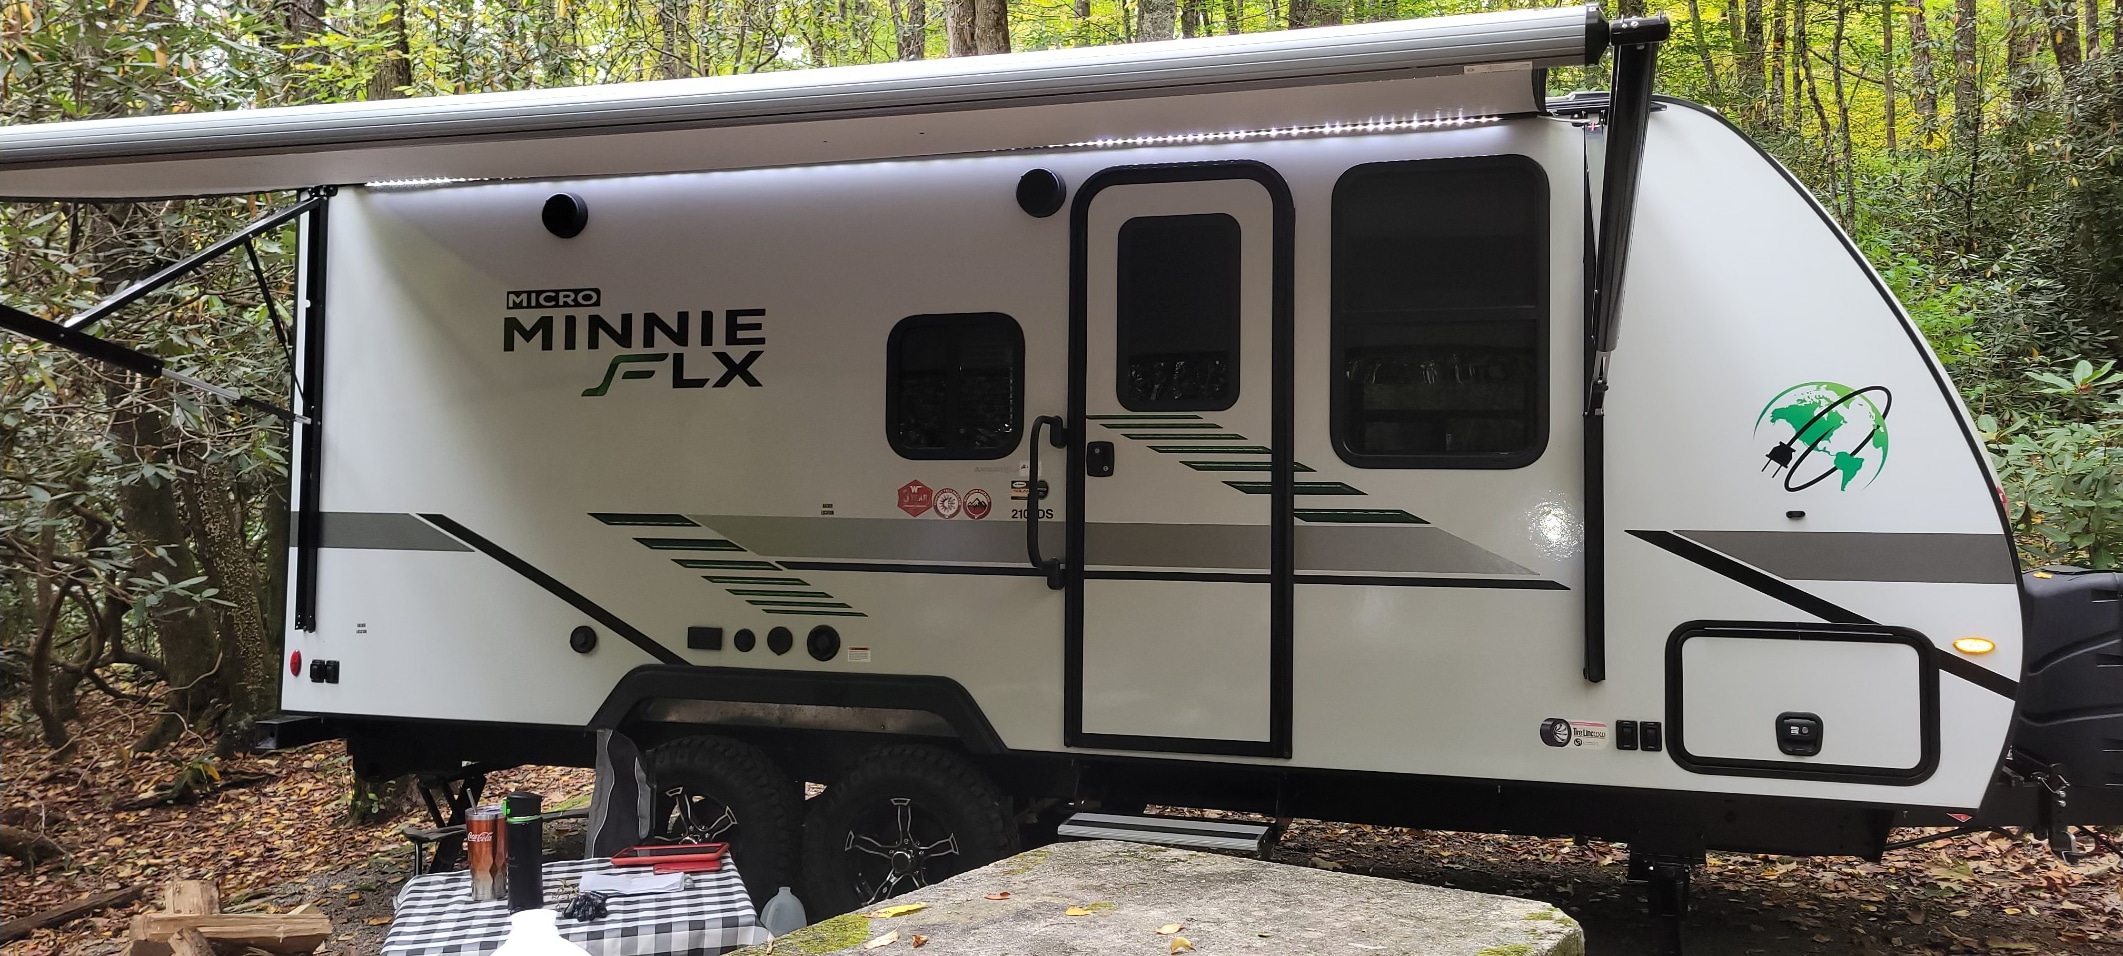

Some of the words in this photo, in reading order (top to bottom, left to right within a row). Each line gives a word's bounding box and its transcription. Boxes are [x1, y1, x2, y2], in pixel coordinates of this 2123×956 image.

[507, 290, 598, 308] MICRO
[503, 308, 766, 352] MINNIE
[581, 350, 765, 397] FLX
[1011, 508, 1054, 520] 210DS
[468, 831, 494, 842] Coca-Cola
